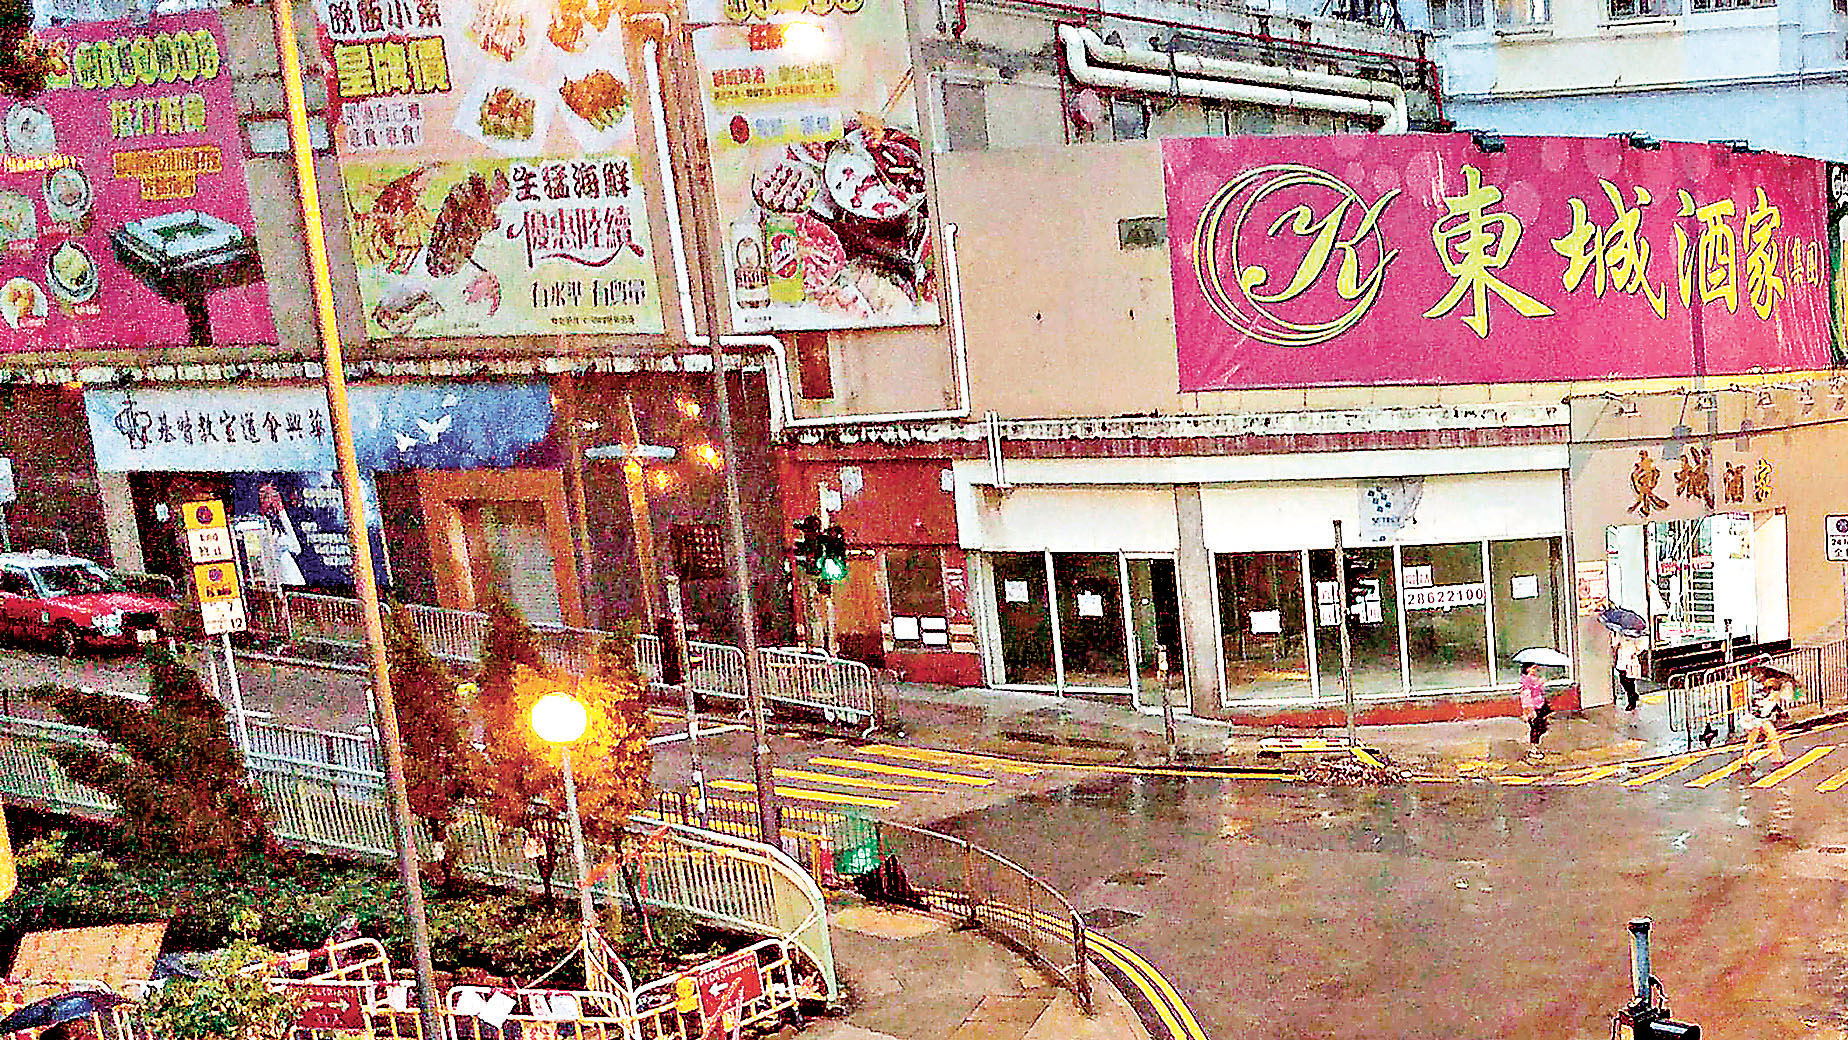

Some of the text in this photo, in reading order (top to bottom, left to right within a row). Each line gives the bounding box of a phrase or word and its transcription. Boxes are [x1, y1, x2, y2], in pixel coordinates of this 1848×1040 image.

[512, 161, 632, 202] 生猛海鮮
[1422, 165, 1785, 339] 東城酒家
[1627, 445, 1774, 518] 東城酒家
[1407, 588, 1484, 606] 28622100
